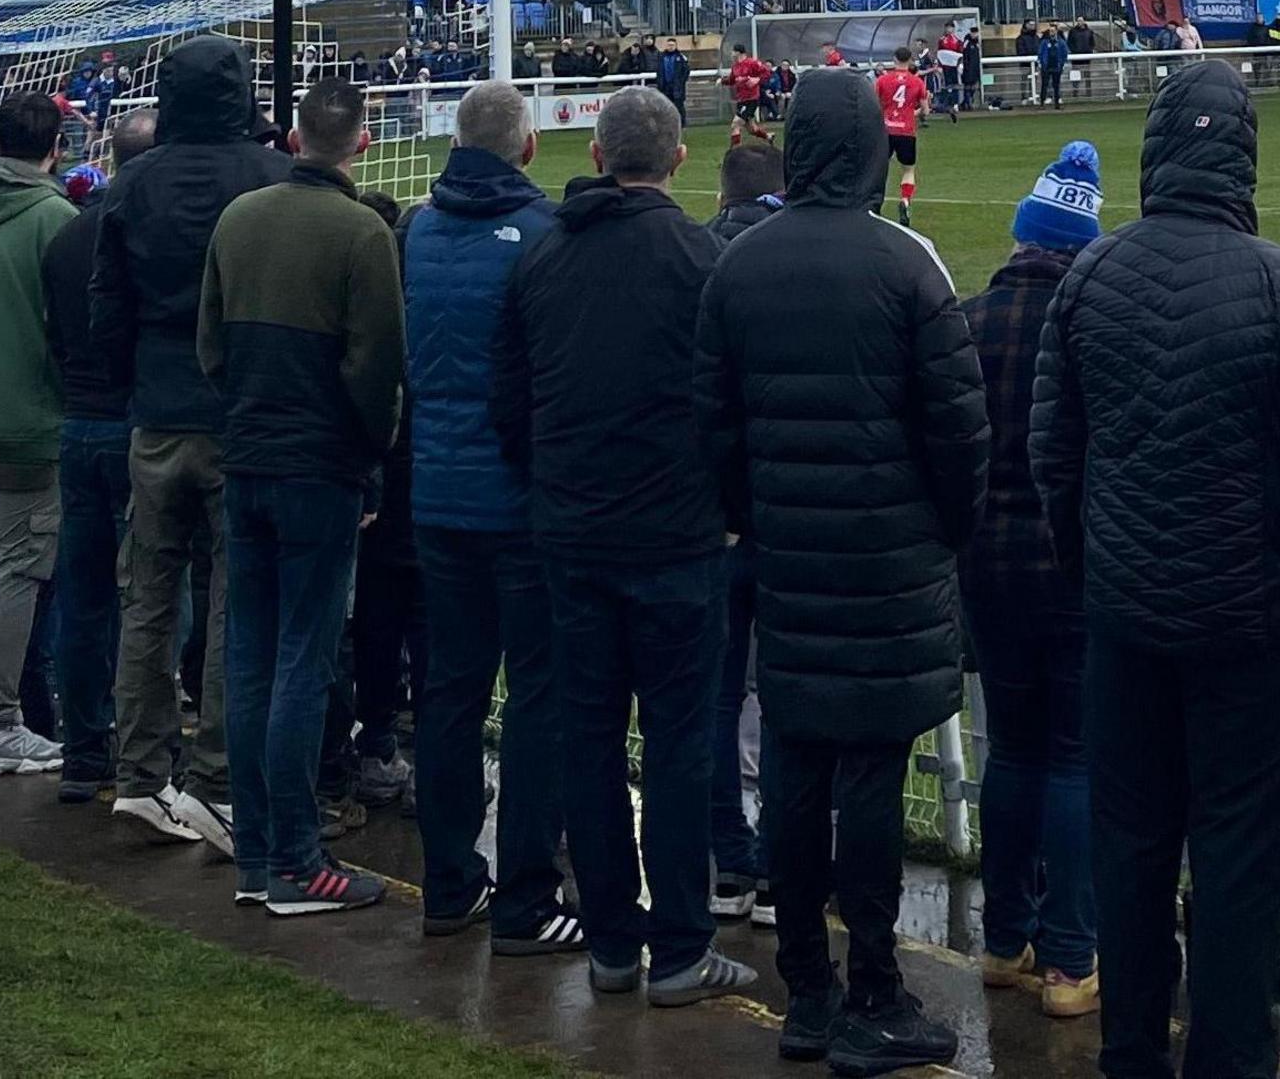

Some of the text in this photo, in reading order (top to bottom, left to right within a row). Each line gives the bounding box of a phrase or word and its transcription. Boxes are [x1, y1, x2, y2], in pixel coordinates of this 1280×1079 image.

[1197, 4, 1243, 16] BANGOR
[892, 84, 906, 108] 4
[1055, 186, 1094, 209] 1876
